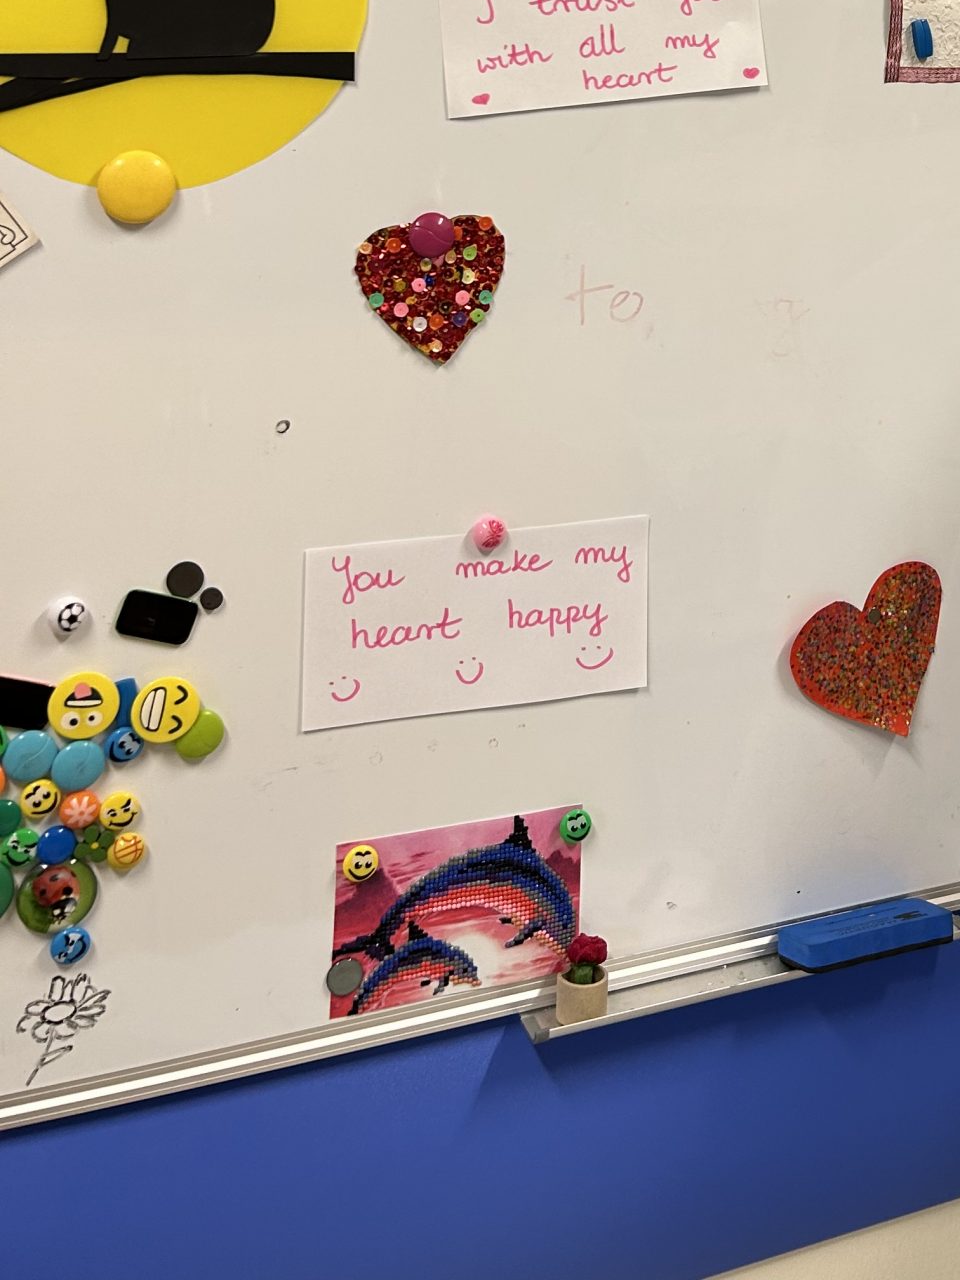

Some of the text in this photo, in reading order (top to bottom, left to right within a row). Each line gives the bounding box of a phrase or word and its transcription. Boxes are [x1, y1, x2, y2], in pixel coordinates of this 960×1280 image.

[477, 23, 719, 74] with all my
[583, 63, 677, 90] heart
[332, 545, 633, 605] You make my
[351, 599, 608, 649] heart happy
